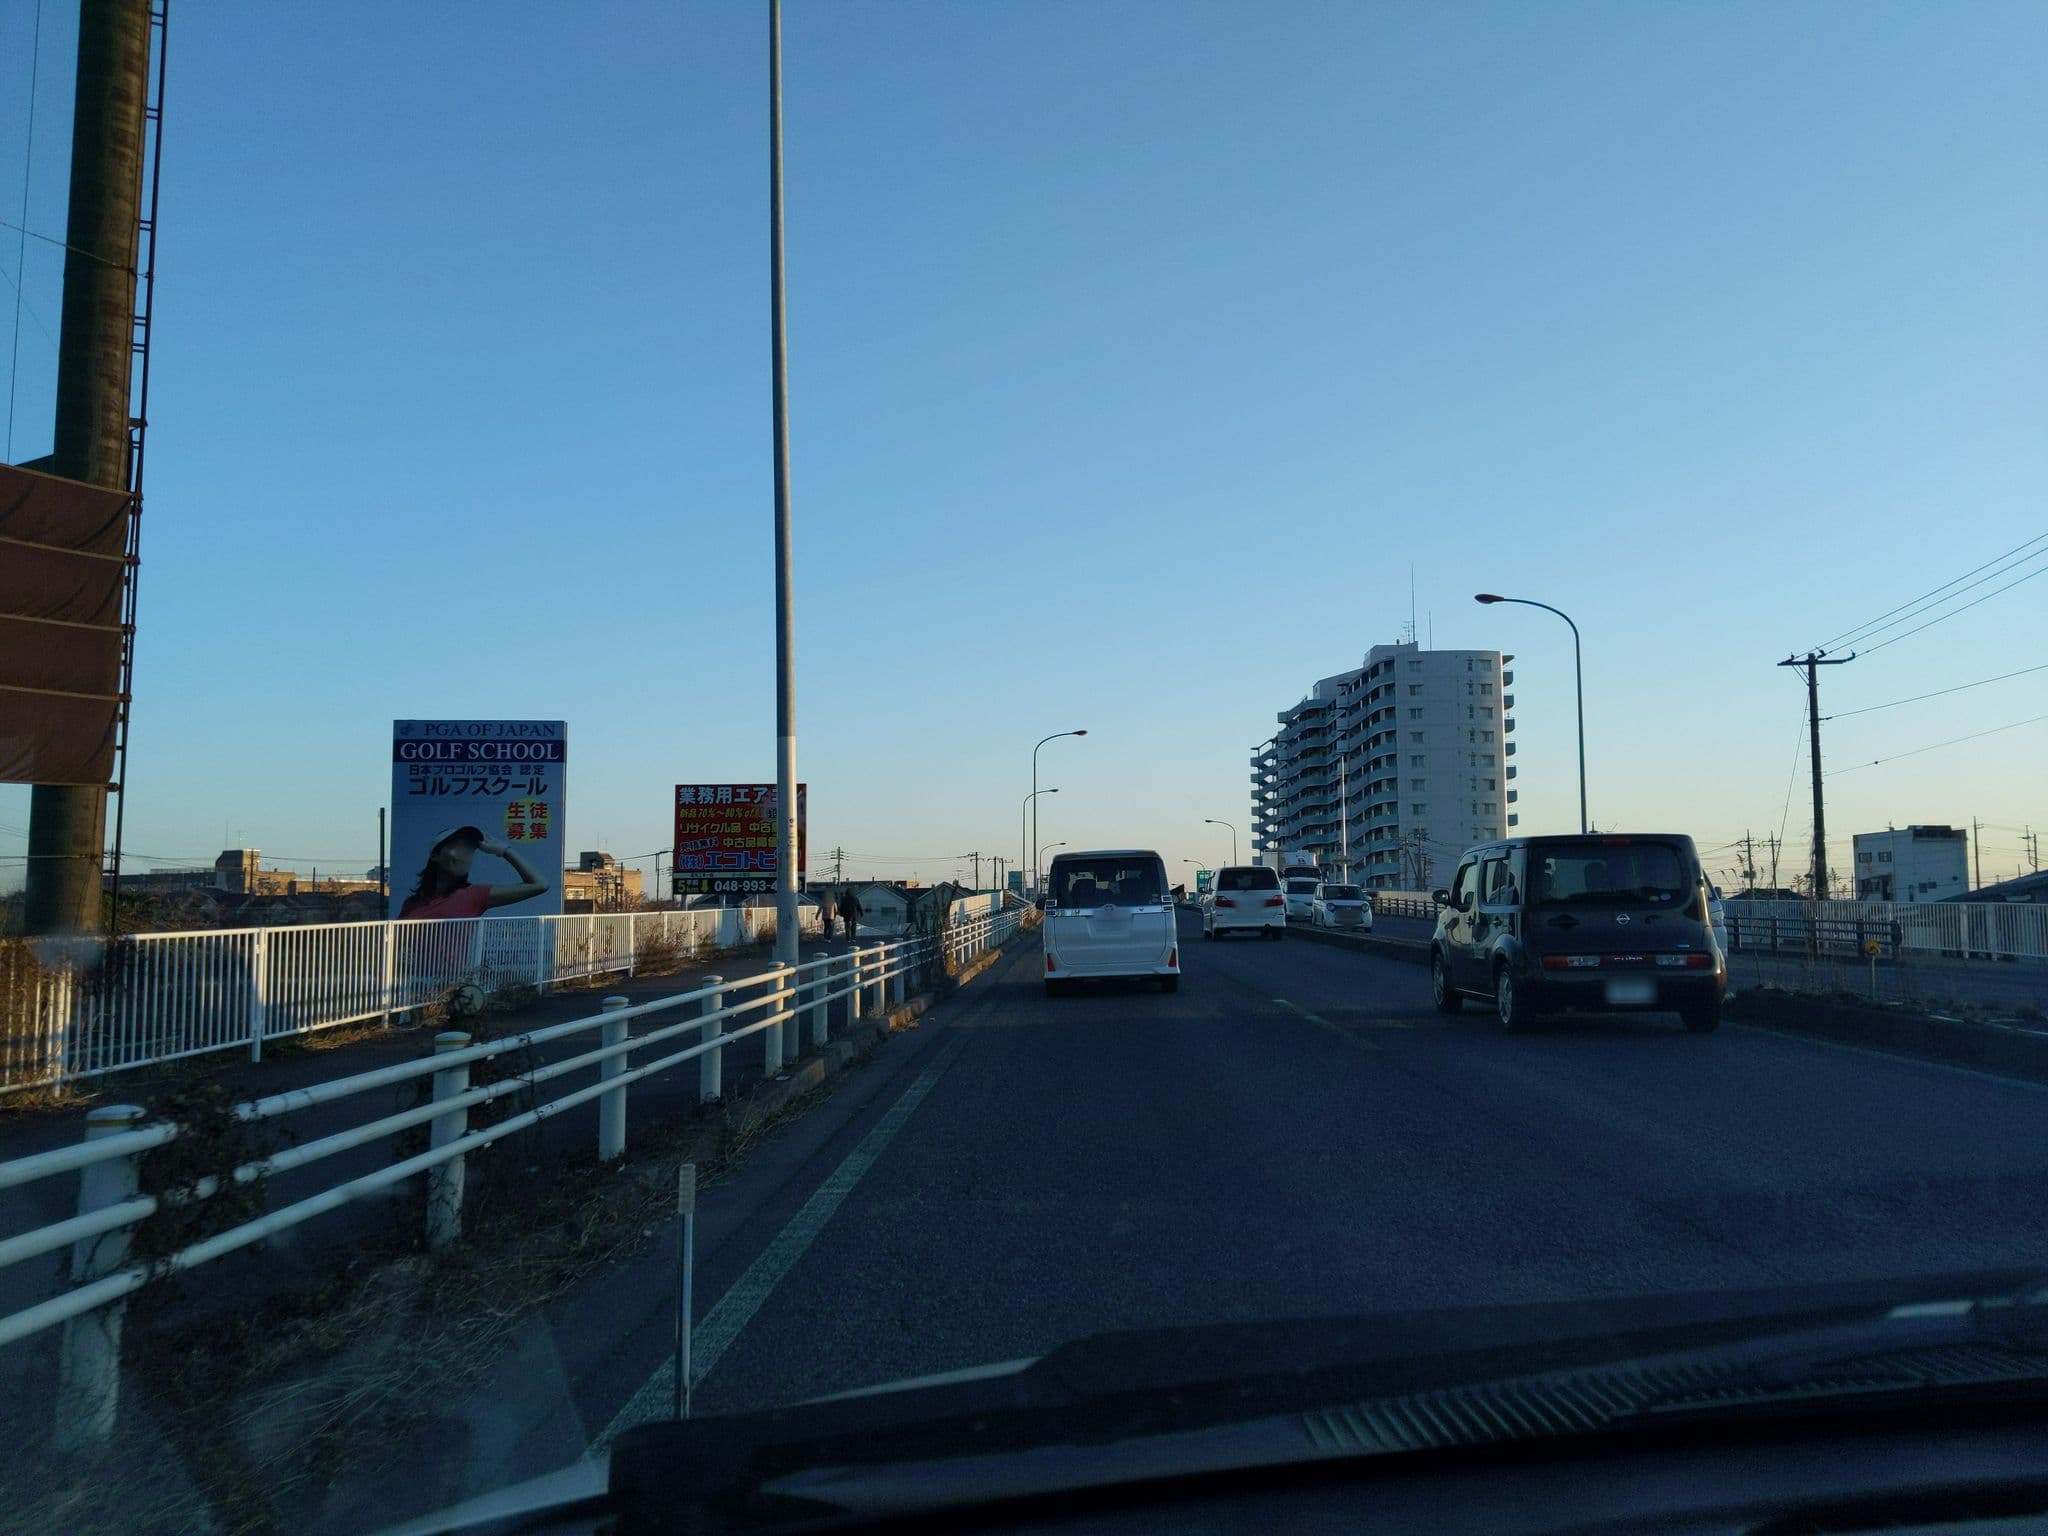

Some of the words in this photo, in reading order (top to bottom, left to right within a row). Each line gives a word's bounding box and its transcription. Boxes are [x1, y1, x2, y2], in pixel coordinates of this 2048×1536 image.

[424, 724, 462, 736] PGA
[467, 724, 492, 736] OF
[496, 724, 555, 736] JAPAN
[400, 742, 463, 760] GOLF
[468, 742, 560, 760] SCHOOL
[408, 777, 548, 796] ゴルフスクール
[679, 787, 802, 805] 業務用エア
[507, 802, 548, 820] 生徒
[507, 823, 548, 840] 募集
